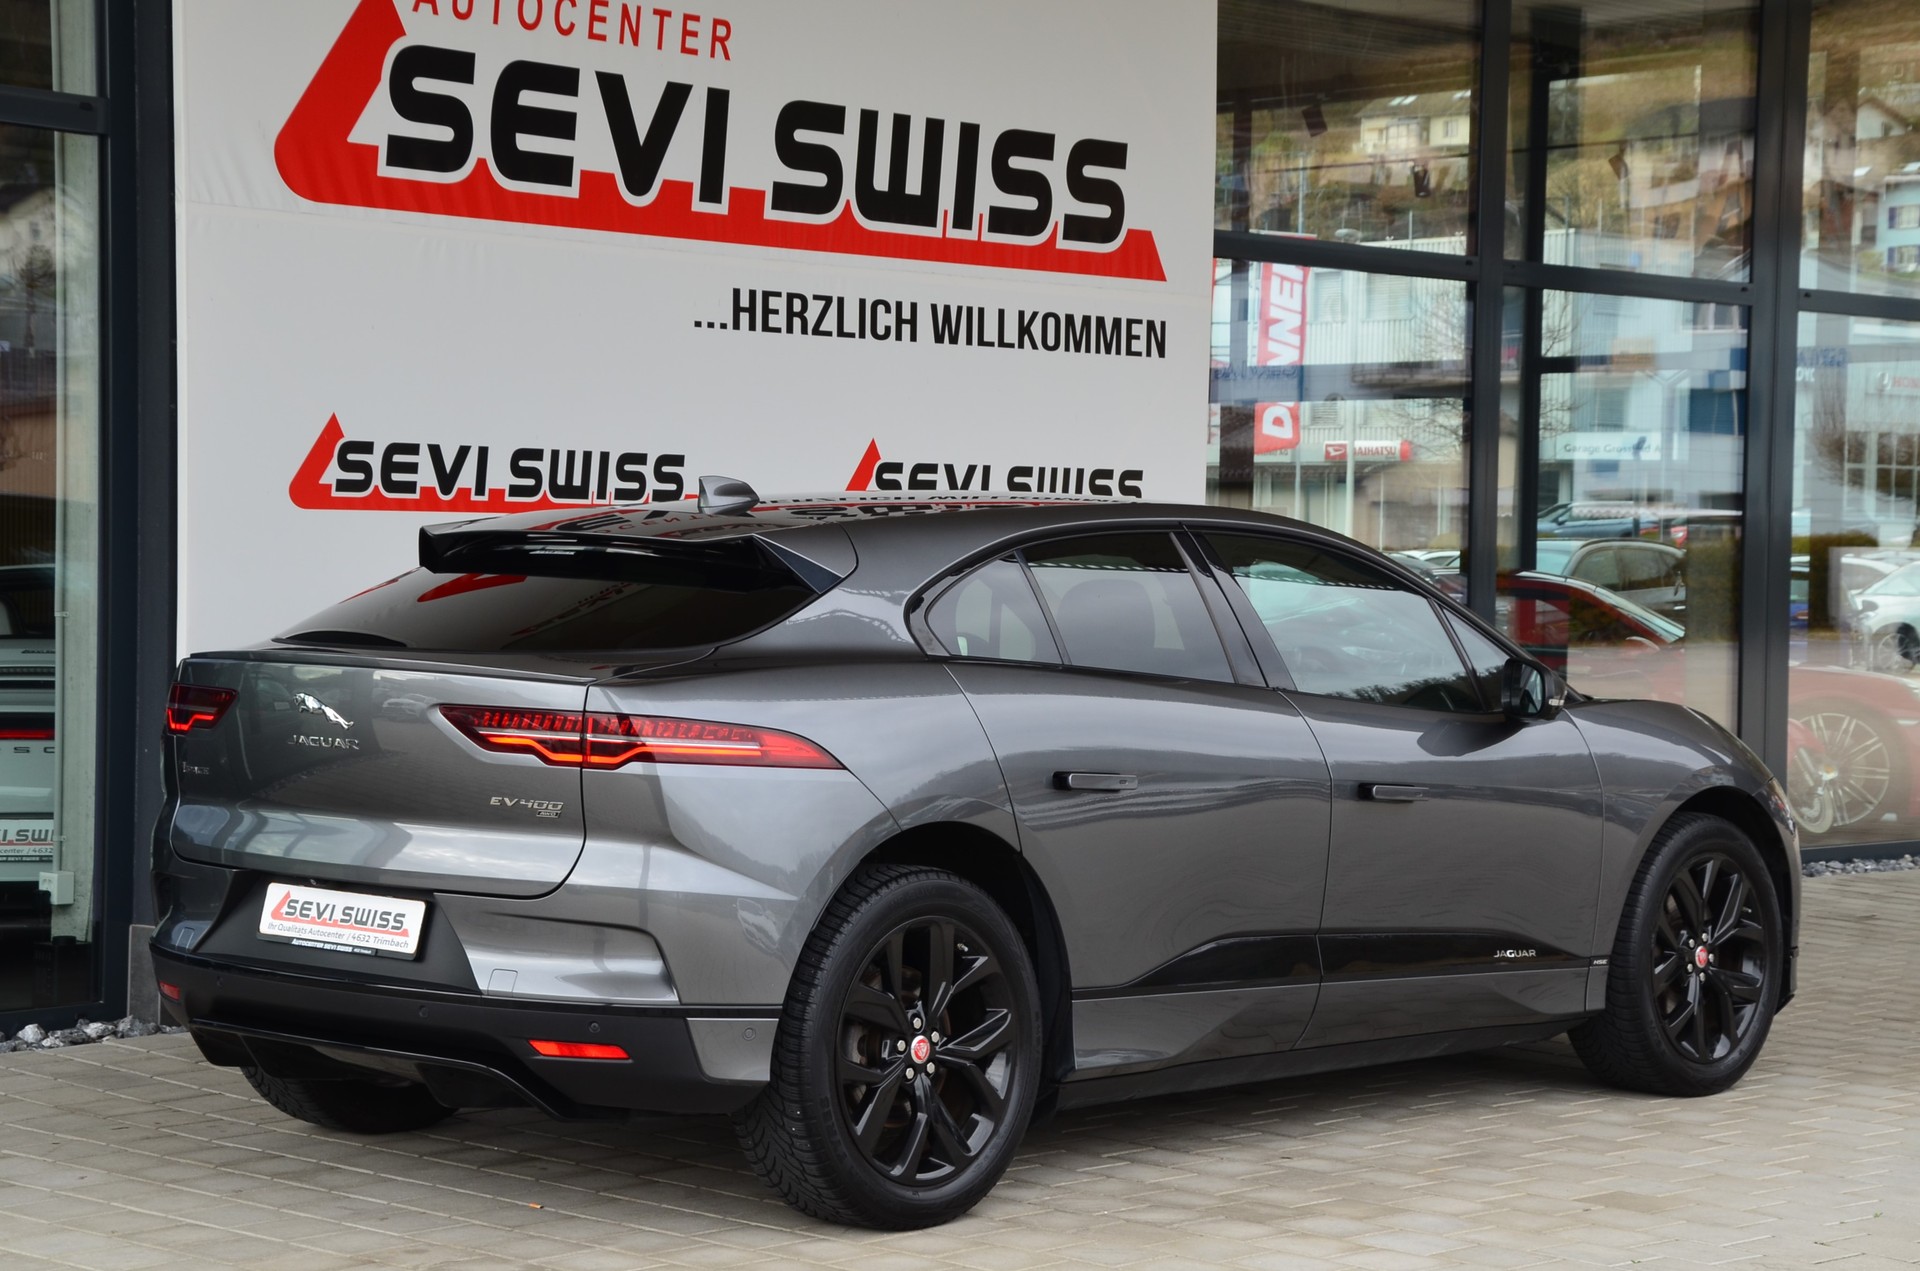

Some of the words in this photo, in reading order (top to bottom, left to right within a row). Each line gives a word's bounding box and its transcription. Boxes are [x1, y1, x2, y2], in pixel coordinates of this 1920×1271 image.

[386, 44, 731, 205] SEVI
[771, 99, 1128, 245] SWISS
[931, 302, 1167, 359] WILLKOMMEN
[334, 440, 489, 497] SEVI
[508, 447, 686, 502] SWISS
[874, 461, 991, 492] SEVI
[287, 734, 360, 750] JAGUAR
[489, 796, 564, 811] EV400
[284, 899, 336, 922] SEVI
[340, 906, 406, 931] SWISS
[308, 928, 345, 940] Autocenter
[351, 933, 371, 943] 4632
[373, 936, 409, 949] Trimbach
[1493, 949, 1537, 958] JAGUAR
